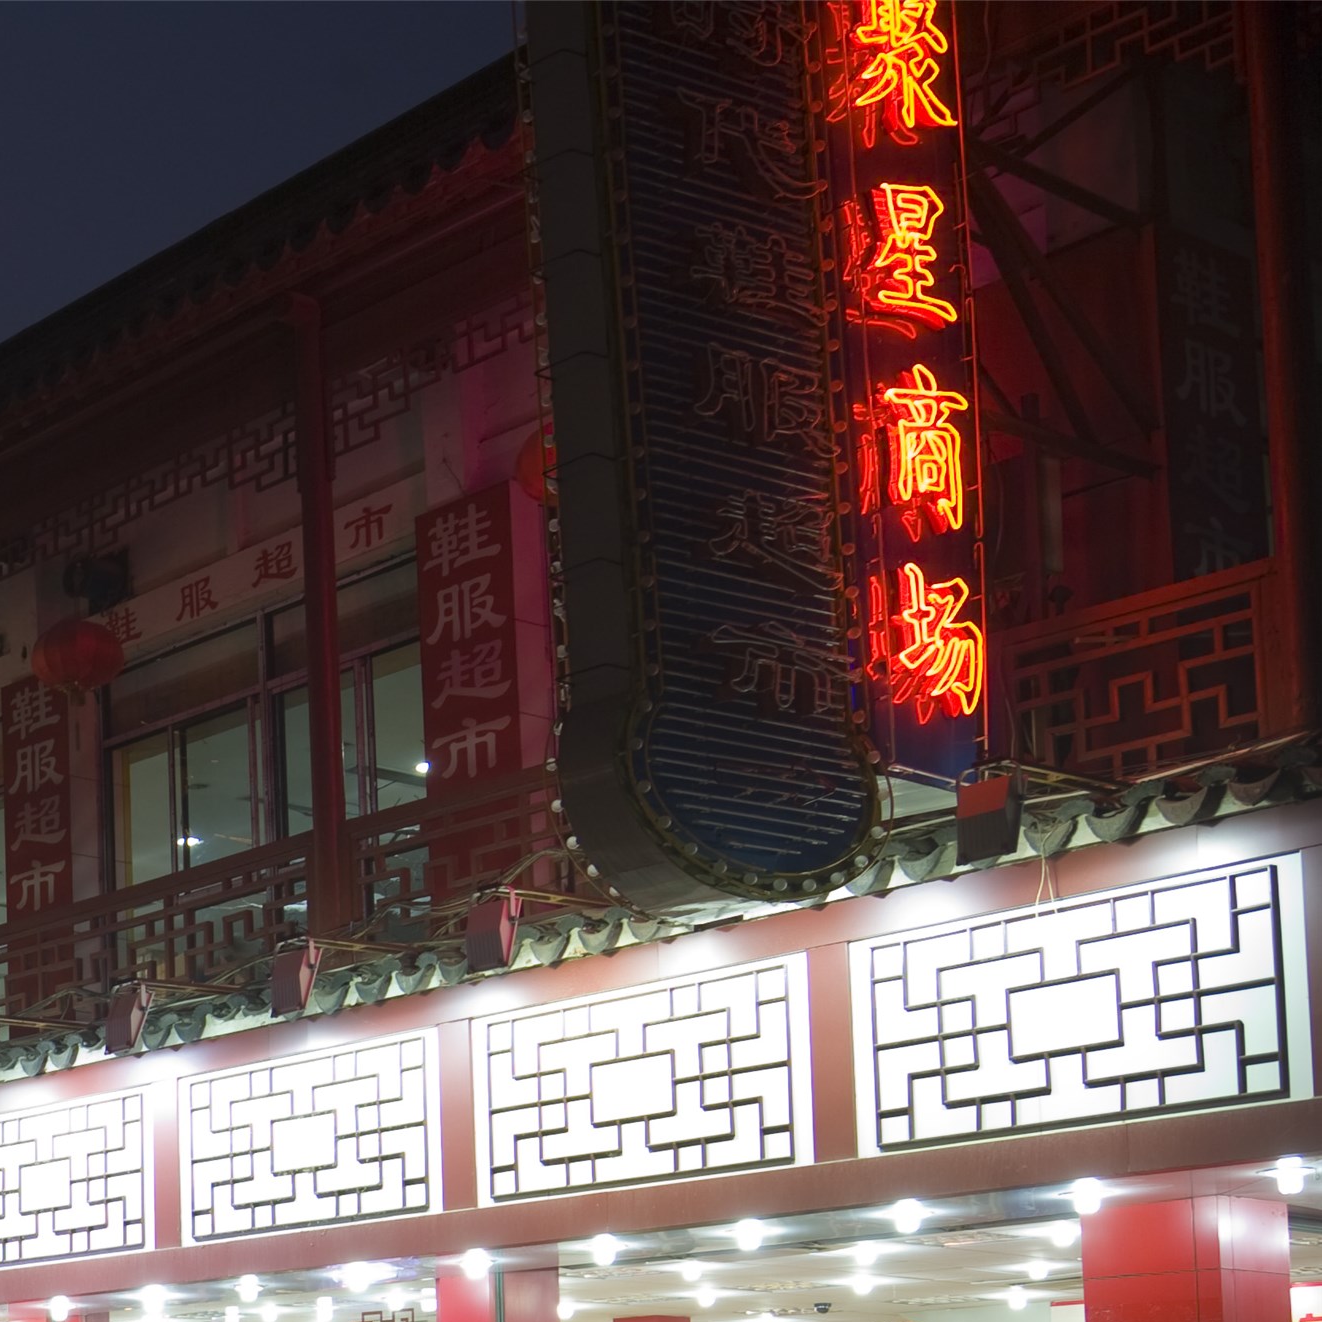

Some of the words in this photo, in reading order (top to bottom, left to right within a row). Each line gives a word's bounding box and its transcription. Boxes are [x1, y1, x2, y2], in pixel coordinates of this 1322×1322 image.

[109, 504, 392, 645] 鞋服超市
[422, 503, 514, 781] 鞋服超市
[6, 684, 66, 912] 鞋服超市
